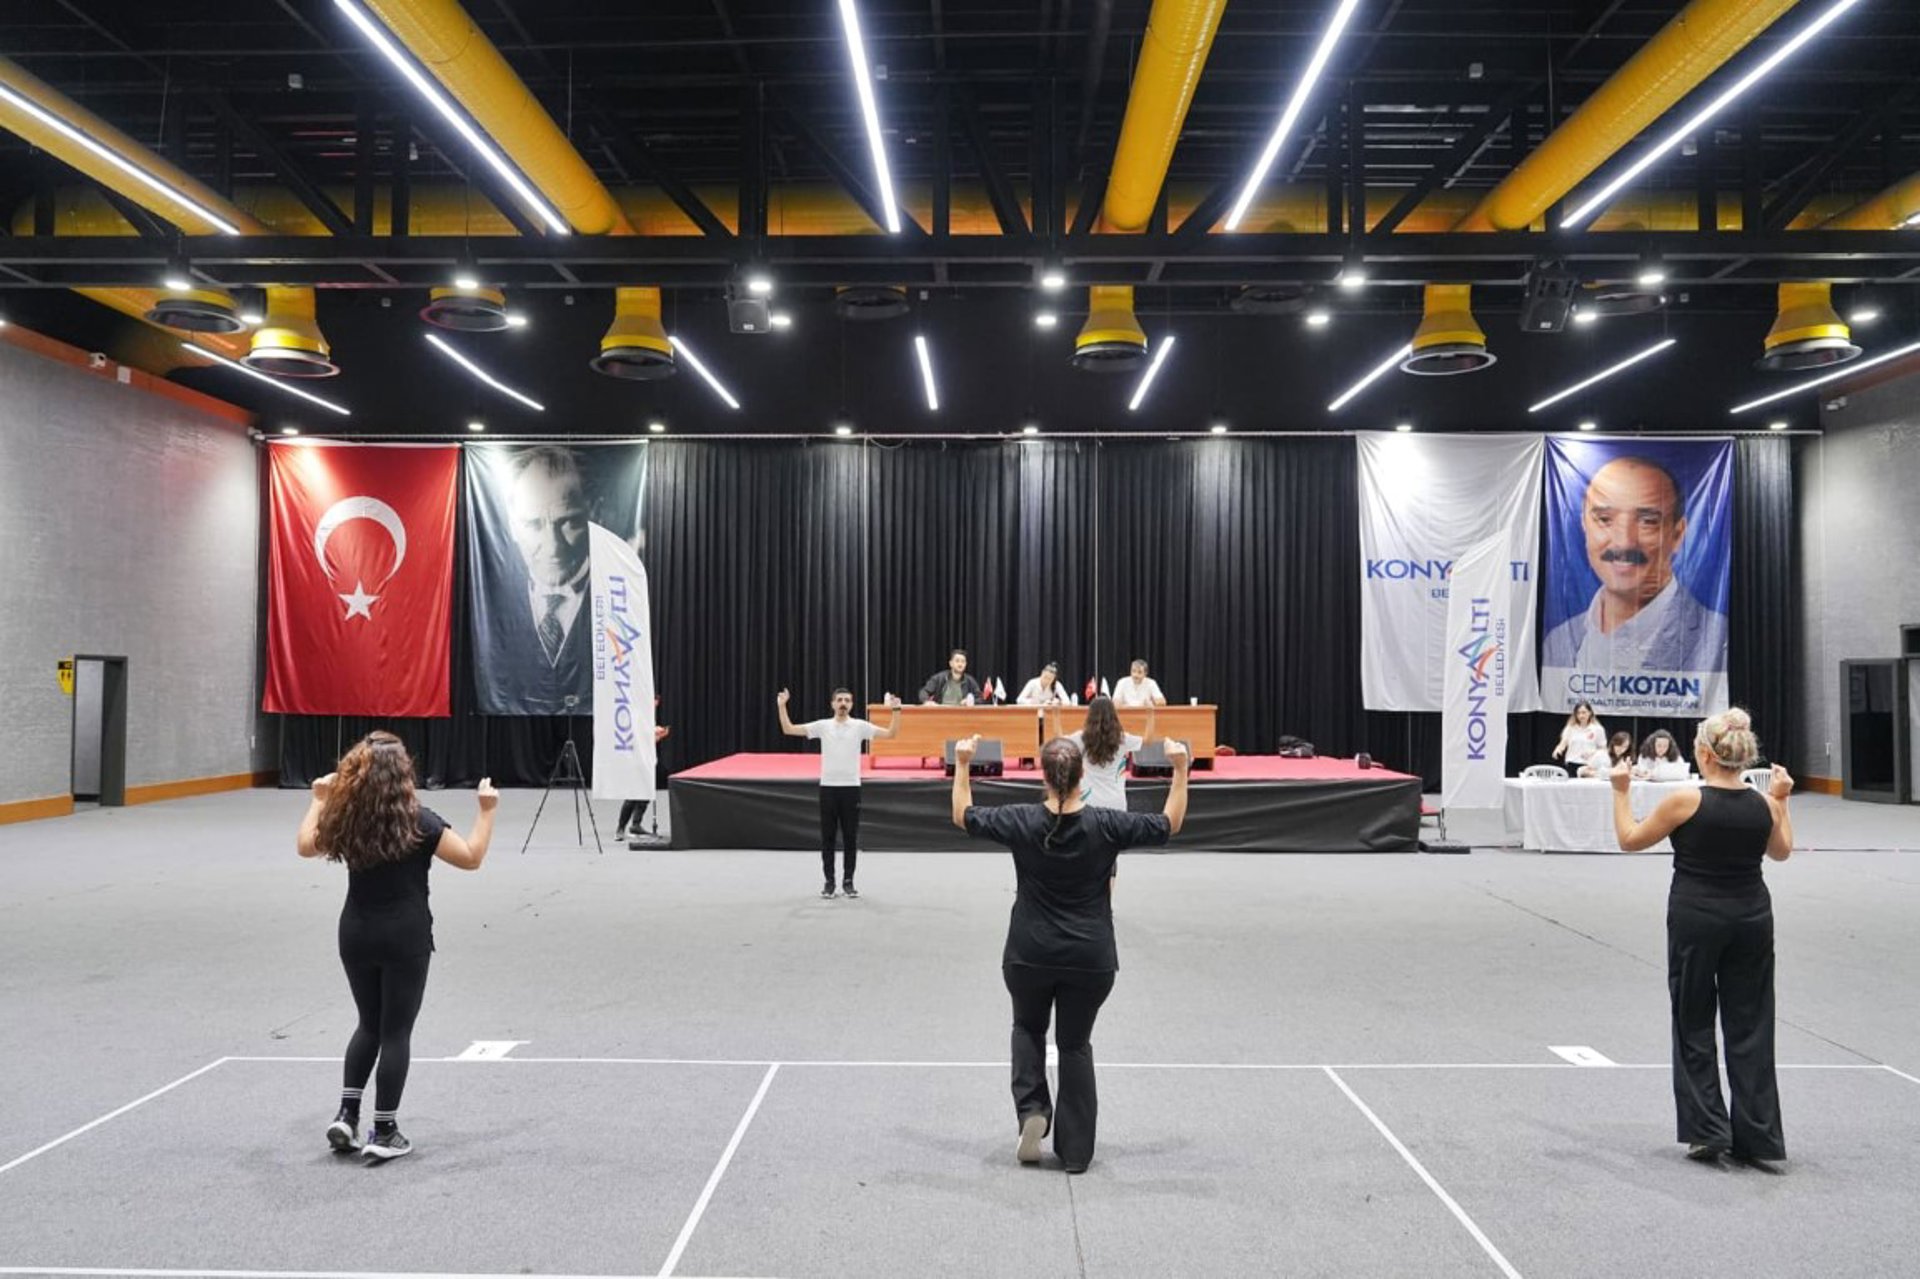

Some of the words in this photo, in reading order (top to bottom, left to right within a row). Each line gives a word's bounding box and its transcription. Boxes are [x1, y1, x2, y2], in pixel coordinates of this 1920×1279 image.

[1367, 559, 1529, 582] KONYTI
[1459, 598, 1492, 760] KONYAALTI
[1568, 674, 1616, 693] CEM
[1619, 676, 1699, 696] KOTAN
